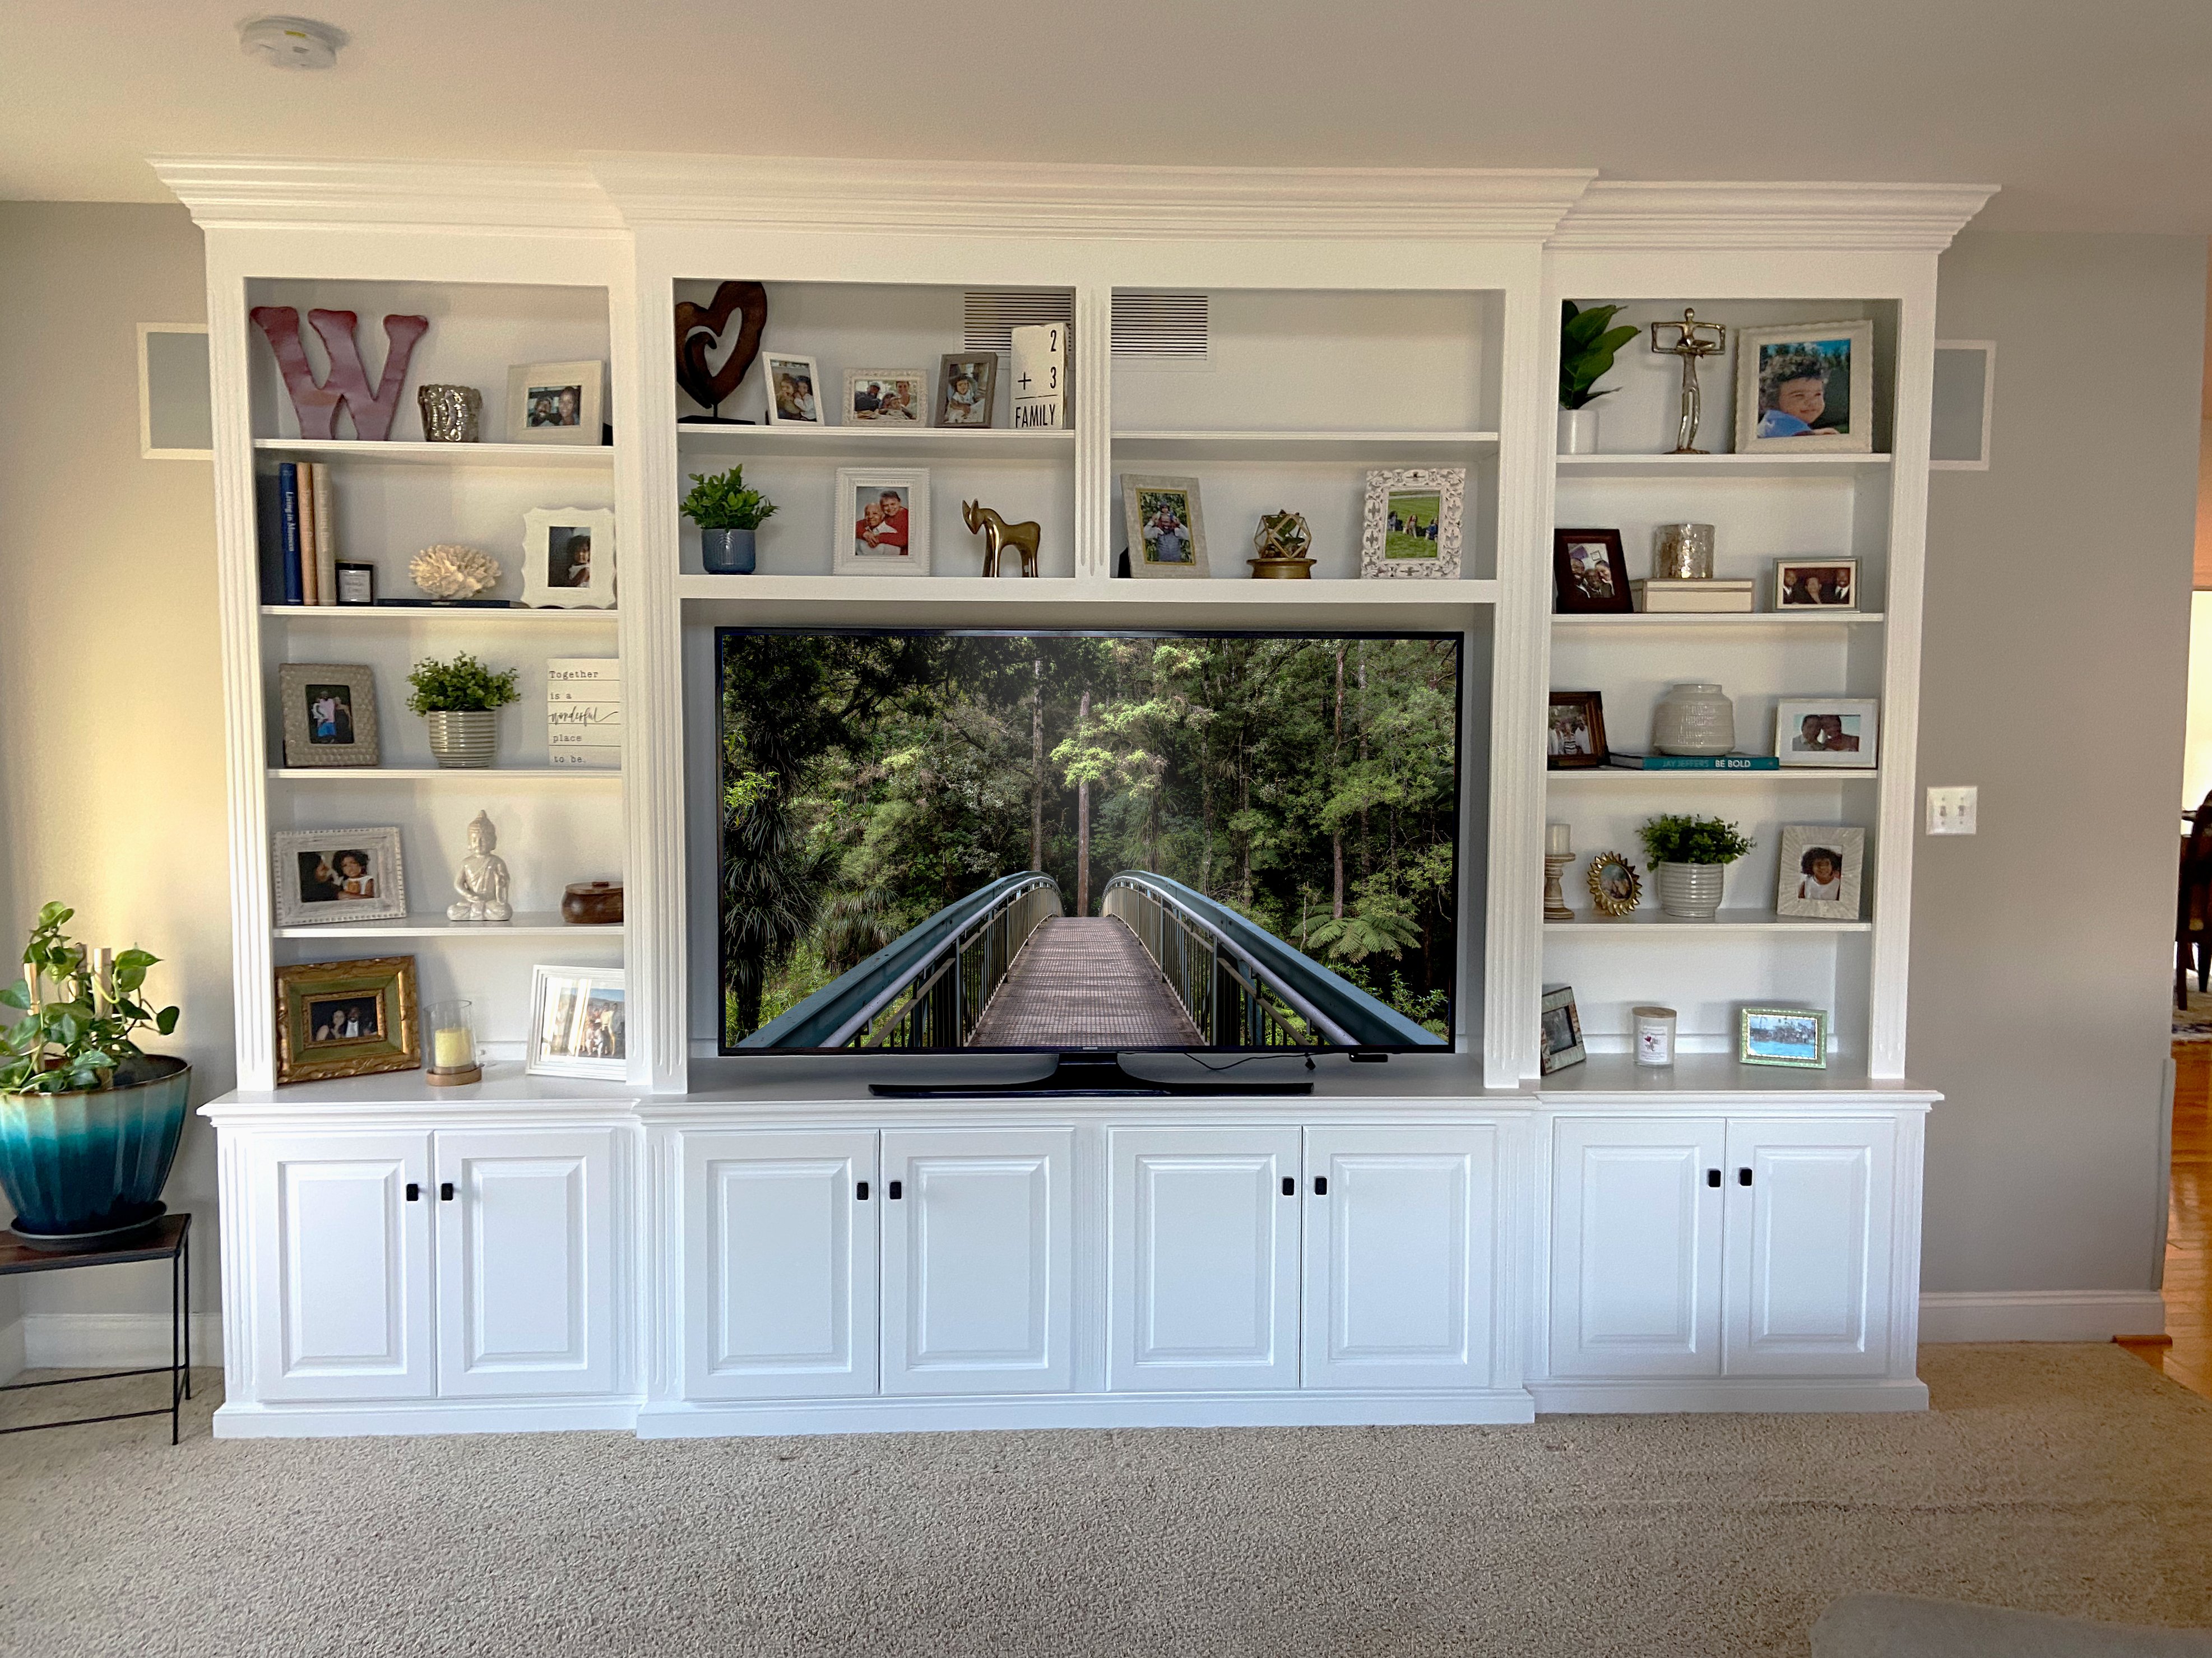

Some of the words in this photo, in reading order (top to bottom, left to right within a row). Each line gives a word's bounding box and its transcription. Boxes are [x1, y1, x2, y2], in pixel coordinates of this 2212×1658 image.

[1050, 329, 1057, 352] 2
[250, 306, 429, 441] W
[1050, 366, 1057, 389] 3
[1015, 404, 1056, 428] FAMILY
[285, 491, 294, 513] Living
[287, 522, 296, 551] Morocco
[549, 670, 599, 680] Together
[548, 705, 619, 727] wonderful
[553, 734, 582, 744] place
[1662, 759, 1677, 768] JAY
[1677, 759, 1709, 768] JEFFERS
[1715, 759, 1726, 768] BE
[1727, 759, 1751, 768] BOLD
